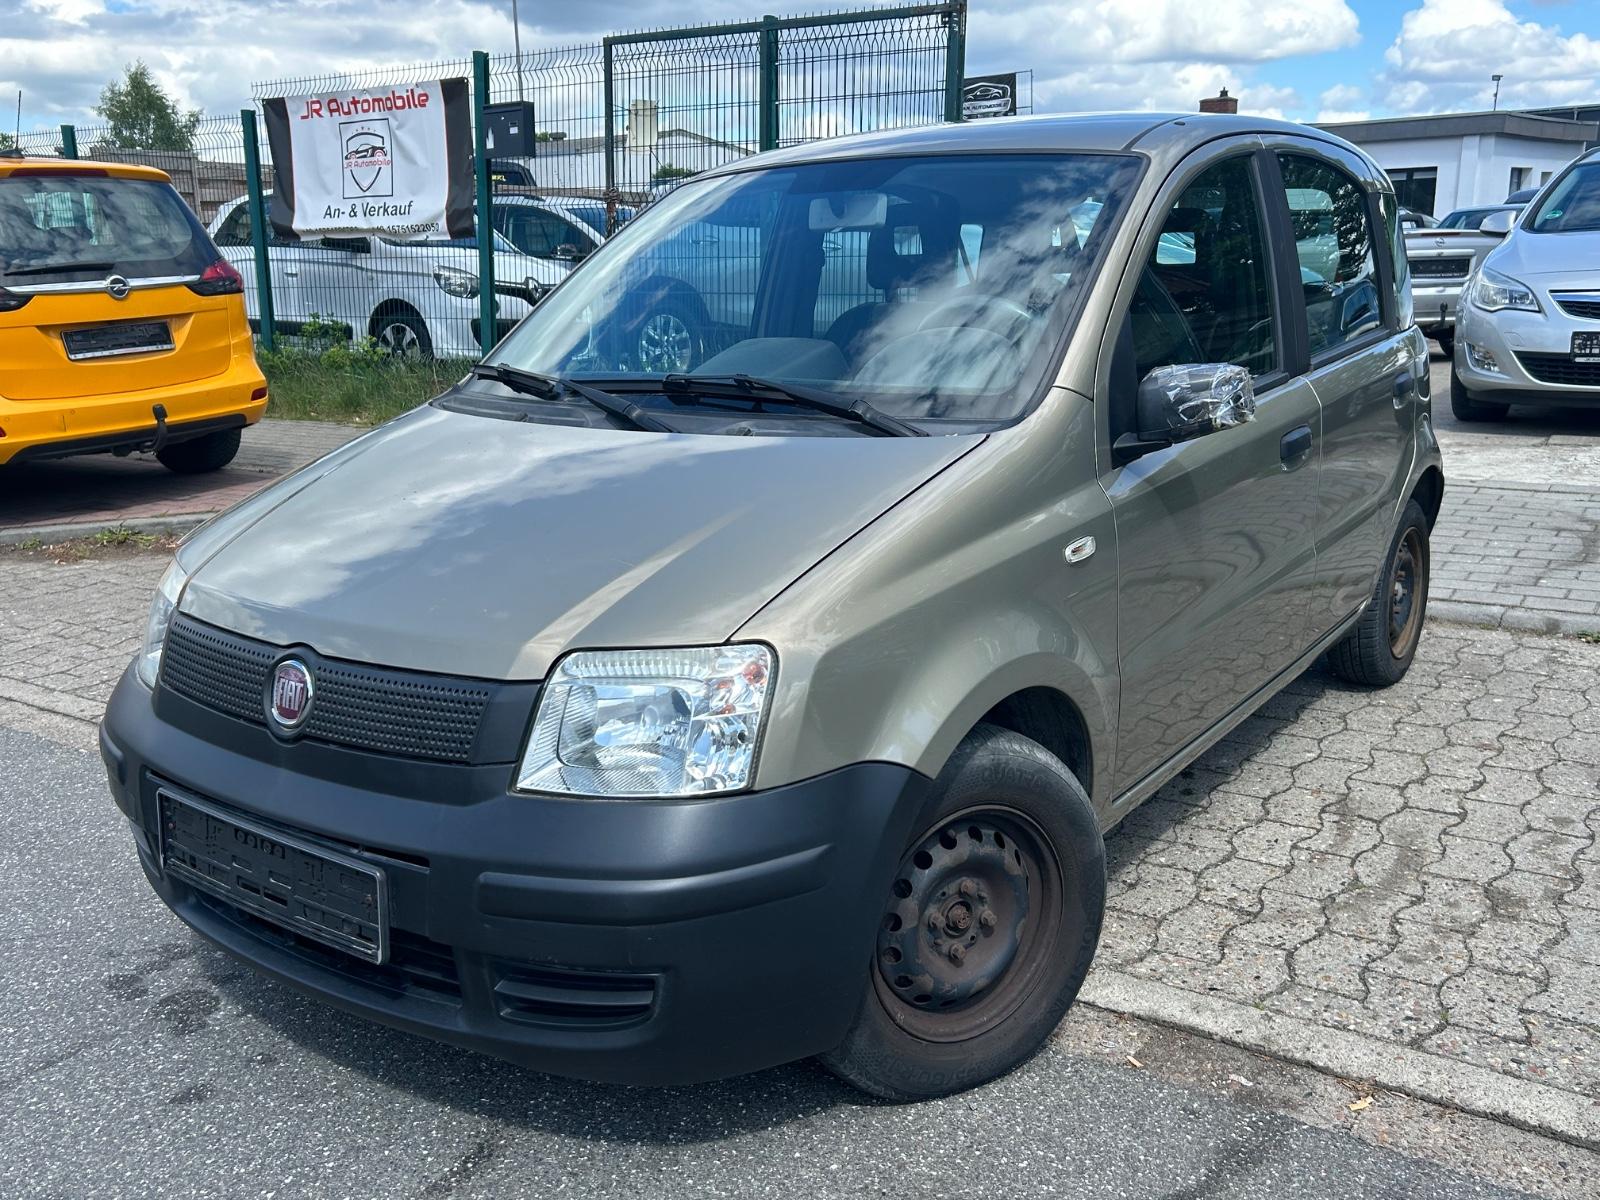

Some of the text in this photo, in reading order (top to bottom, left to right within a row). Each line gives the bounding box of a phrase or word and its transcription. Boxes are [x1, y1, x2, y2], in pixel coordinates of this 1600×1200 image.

[300, 88, 429, 120] JR Automobile
[354, 159, 391, 168] Automobile
[323, 200, 413, 219] An- & Verkauf
[277, 677, 304, 711] FIAT
